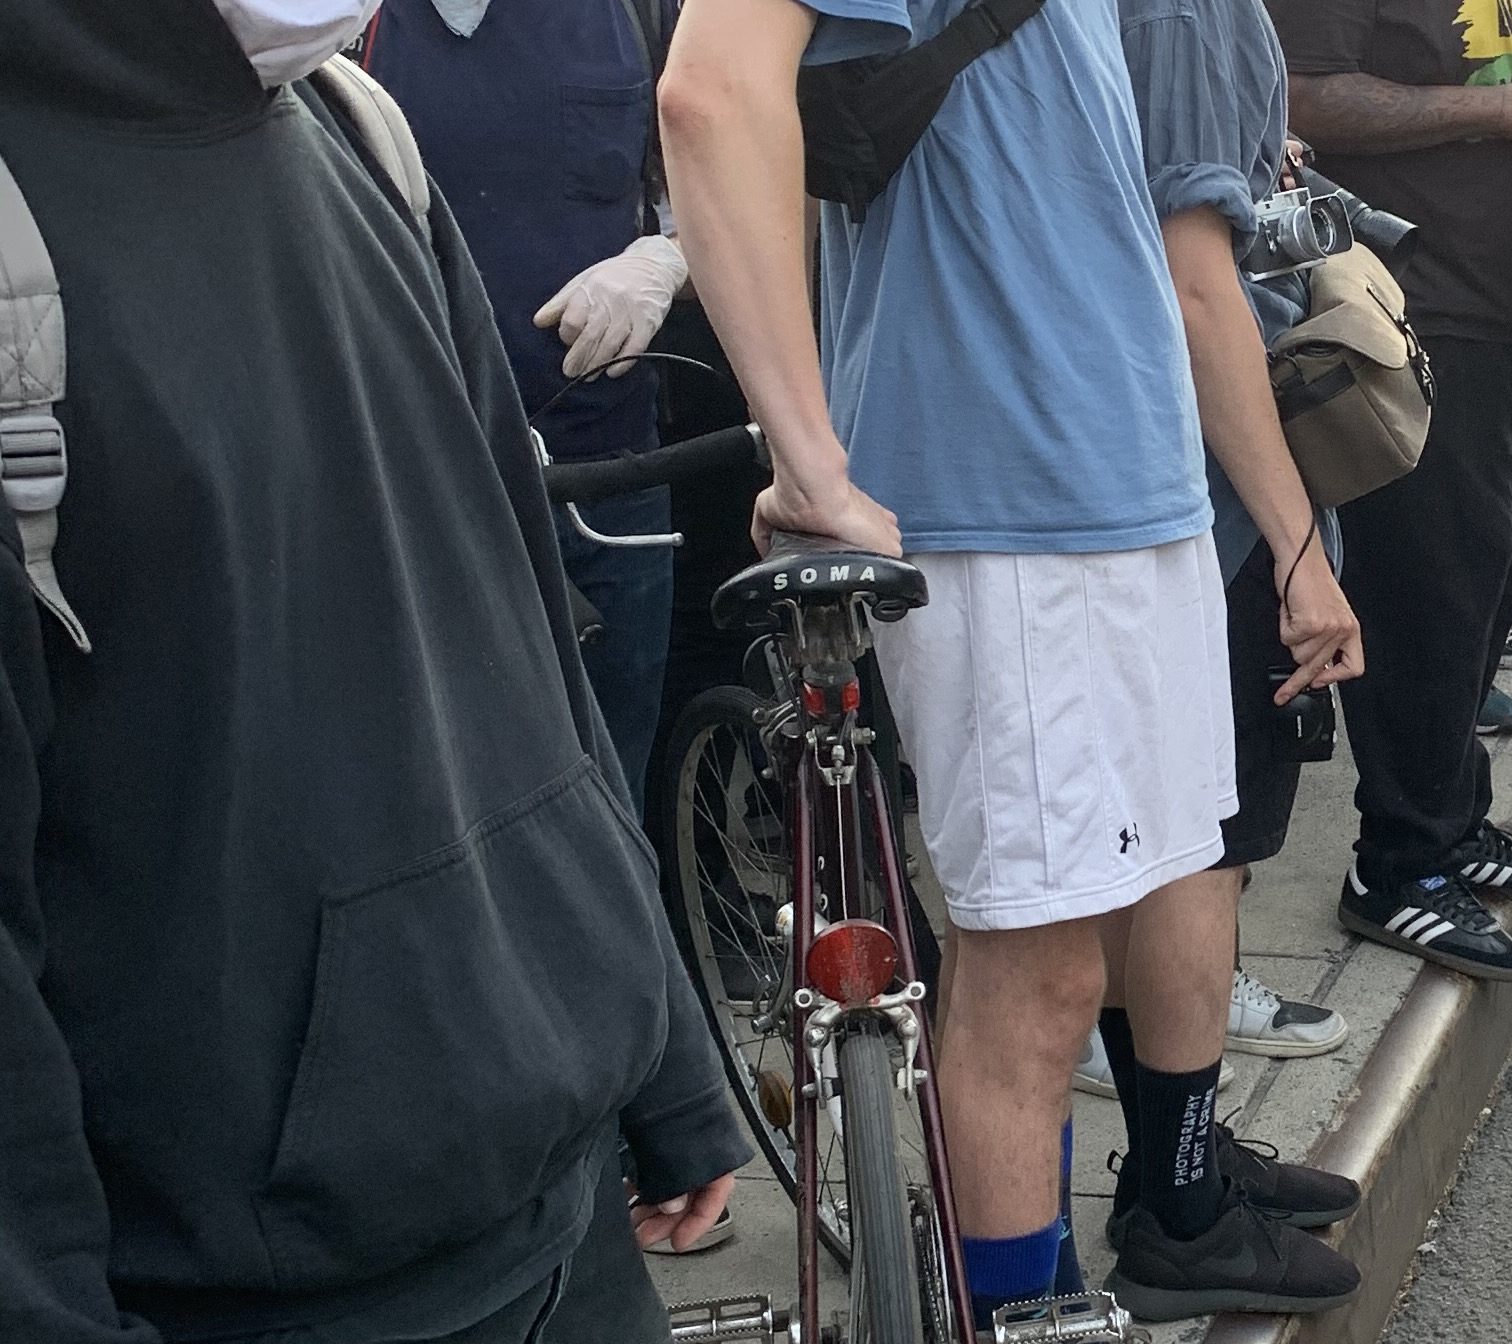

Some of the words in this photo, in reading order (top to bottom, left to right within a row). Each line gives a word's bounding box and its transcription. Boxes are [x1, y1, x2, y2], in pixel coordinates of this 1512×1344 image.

[774, 565, 875, 590] SOMA
[1175, 1095, 1201, 1186] PHOTOGRAPHY
[1192, 1141, 1206, 1167] NOT
